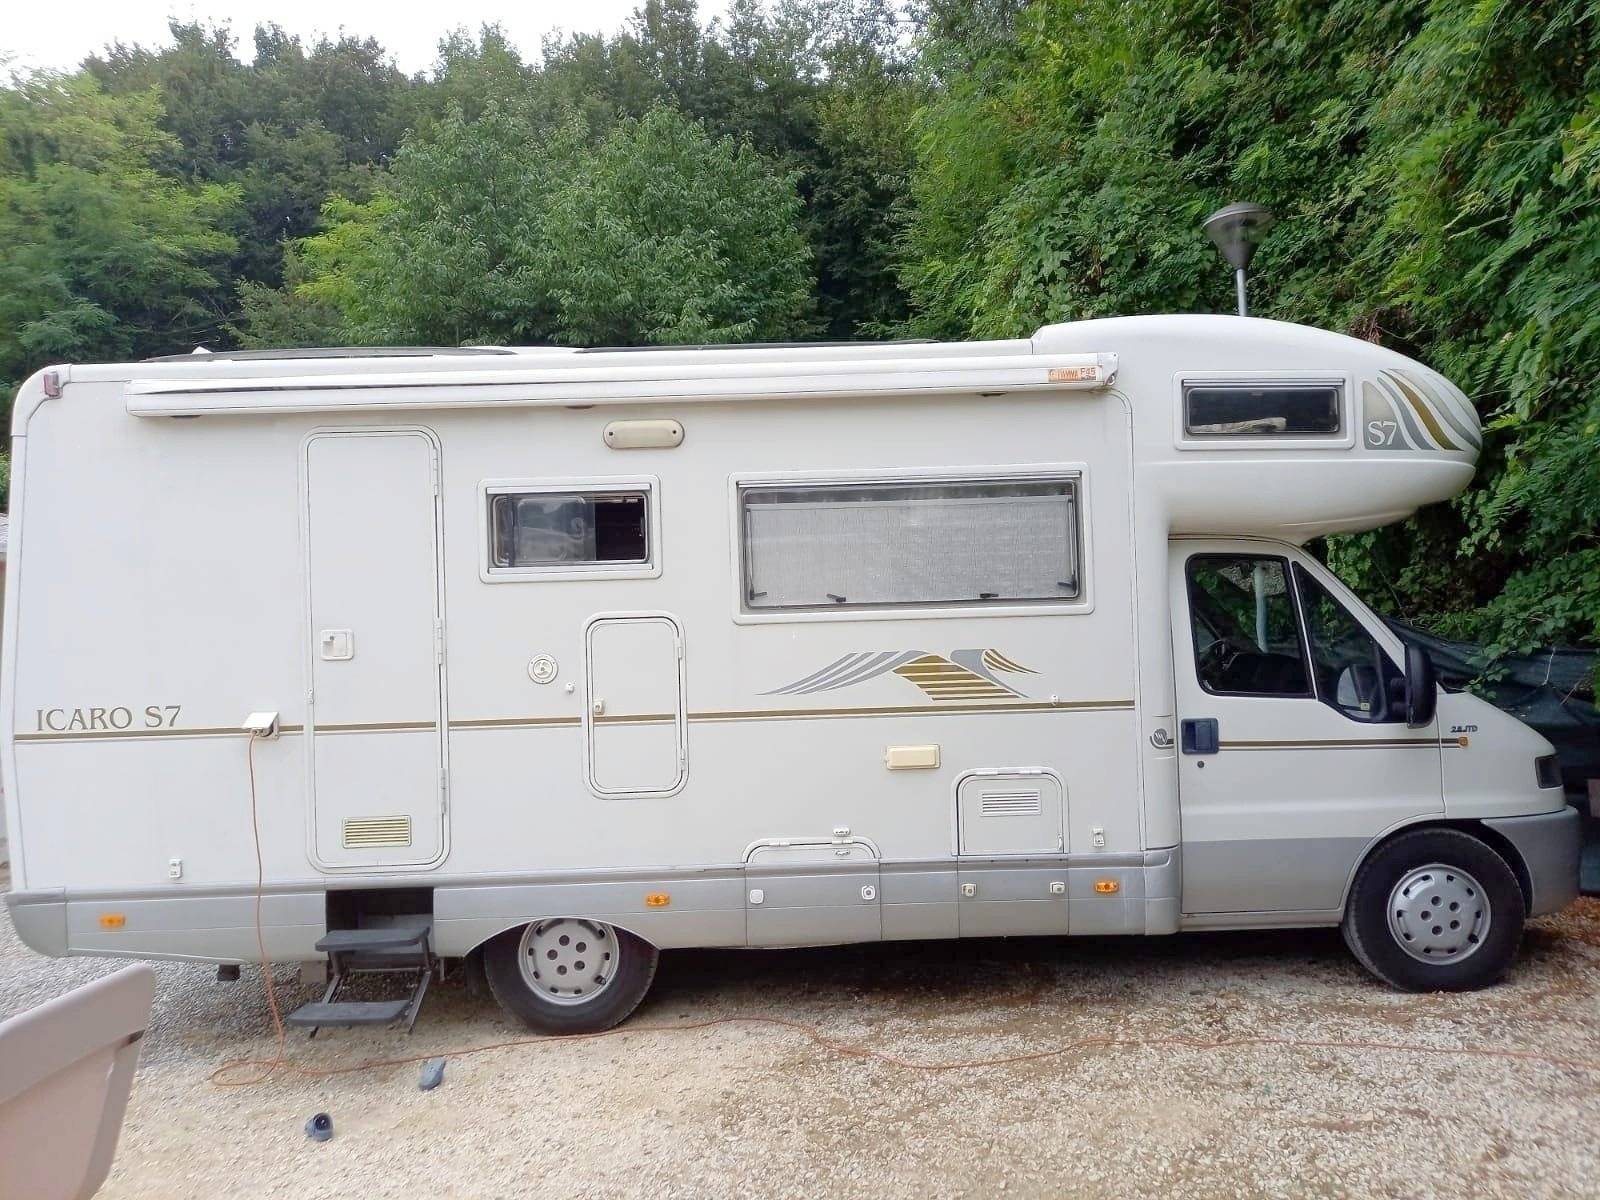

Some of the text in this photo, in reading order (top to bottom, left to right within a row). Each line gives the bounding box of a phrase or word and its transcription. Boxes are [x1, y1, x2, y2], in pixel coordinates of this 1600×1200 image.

[1080, 367, 1096, 376] F45
[1368, 420, 1397, 446] S7
[36, 704, 182, 731] ICARO S7
